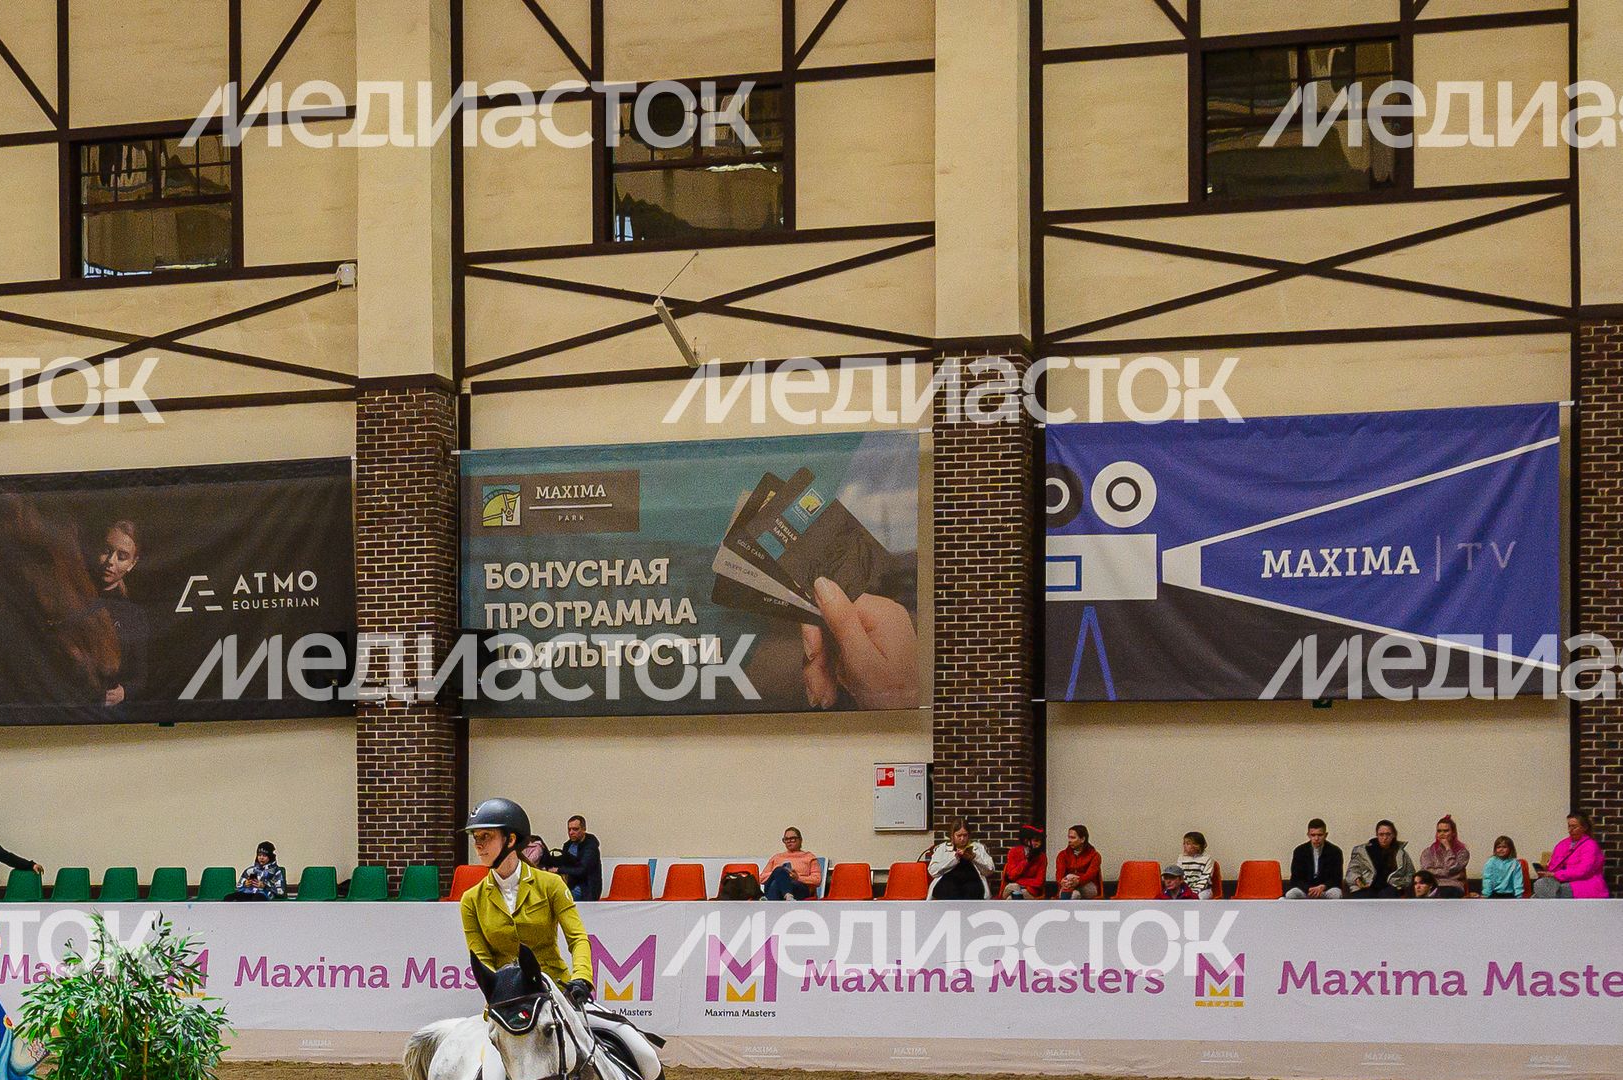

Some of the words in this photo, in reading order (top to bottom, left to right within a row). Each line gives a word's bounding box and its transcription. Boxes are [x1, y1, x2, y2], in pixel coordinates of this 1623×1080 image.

[535, 484, 606, 500] MAXIMA
[484, 558, 669, 590] БОНУСНАЯ
[1261, 545, 1420, 578] MAXIMA
[1457, 541, 1516, 571] TV
[233, 570, 318, 594] ATMO
[233, 597, 319, 610] EQUESTRIAN
[484, 598, 697, 630] ПРОГРАММА
[234, 955, 390, 989] Maxima
[801, 959, 975, 993] Maxima
[988, 960, 1165, 994] Masters
[1277, 960, 1467, 996] Maxima
[619, 1007, 652, 1017] Masters
[704, 1009, 739, 1017] Maxima
[742, 1009, 776, 1018] Masters
